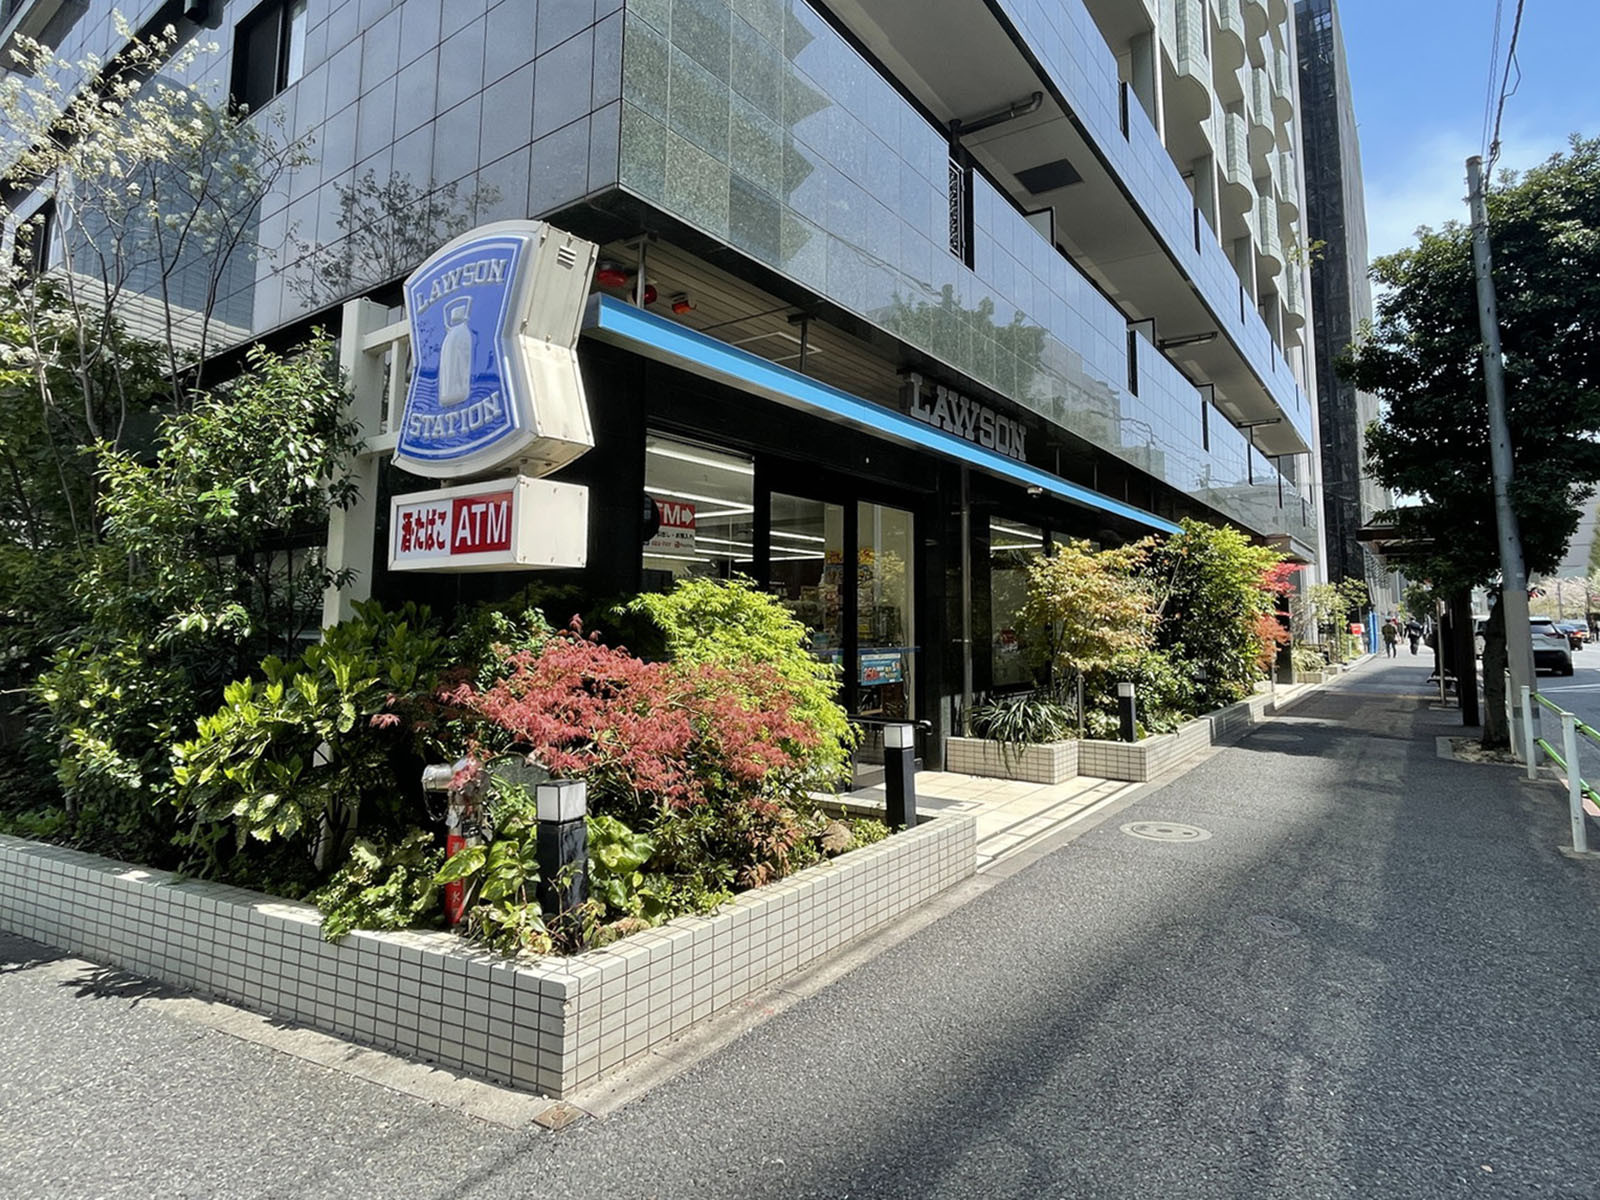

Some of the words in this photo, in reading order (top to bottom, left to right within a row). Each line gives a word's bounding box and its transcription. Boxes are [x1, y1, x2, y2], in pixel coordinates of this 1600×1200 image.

[417, 258, 508, 314] LAWSON
[408, 390, 502, 440] STATION
[910, 371, 1027, 462] LAWSON
[455, 500, 508, 547] ATM
